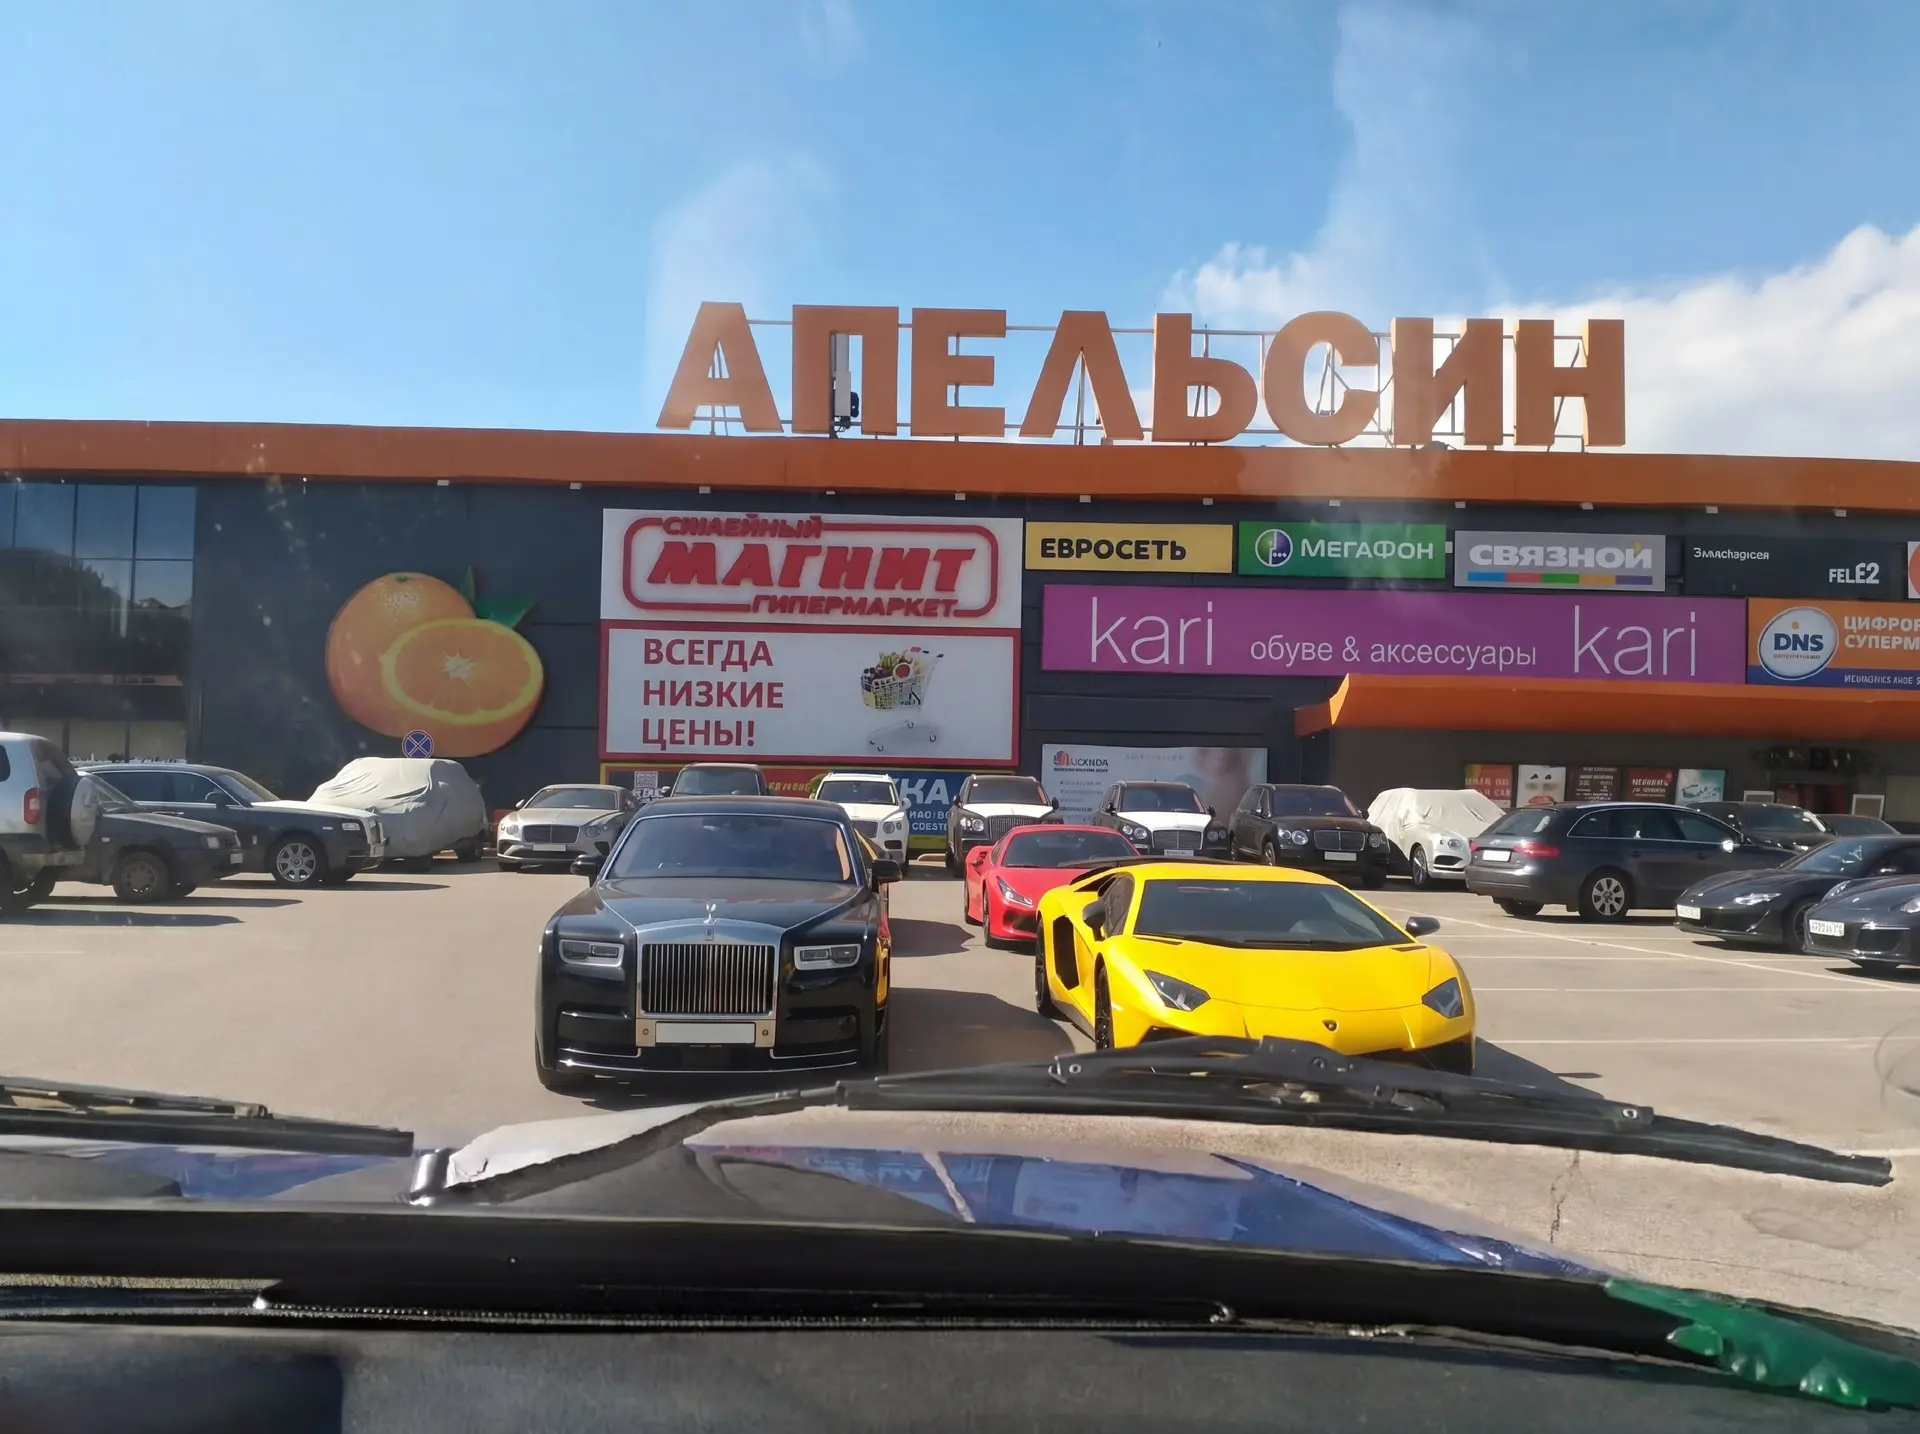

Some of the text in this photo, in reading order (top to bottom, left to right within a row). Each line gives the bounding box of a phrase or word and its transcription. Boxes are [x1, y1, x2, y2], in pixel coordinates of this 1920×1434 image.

[656, 301, 1627, 447] АПЕЛЬСИН
[1041, 537, 1187, 561] ЕВРОСЕТЬ
[1468, 542, 1653, 569] СВЯЗНОЙ
[647, 541, 976, 592] МАГНИТ
[752, 595, 958, 618] ГИПЕРМАРКЕТ
[1090, 597, 1214, 665] kari
[1573, 604, 1698, 677] kari
[1774, 633, 1824, 651] DNS
[644, 639, 773, 672] ВСЕГДА
[1250, 634, 1537, 672] обуве & аксессуары
[643, 680, 784, 709] НИЗКИЕ
[641, 719, 755, 751] ЦЕНЫ!
